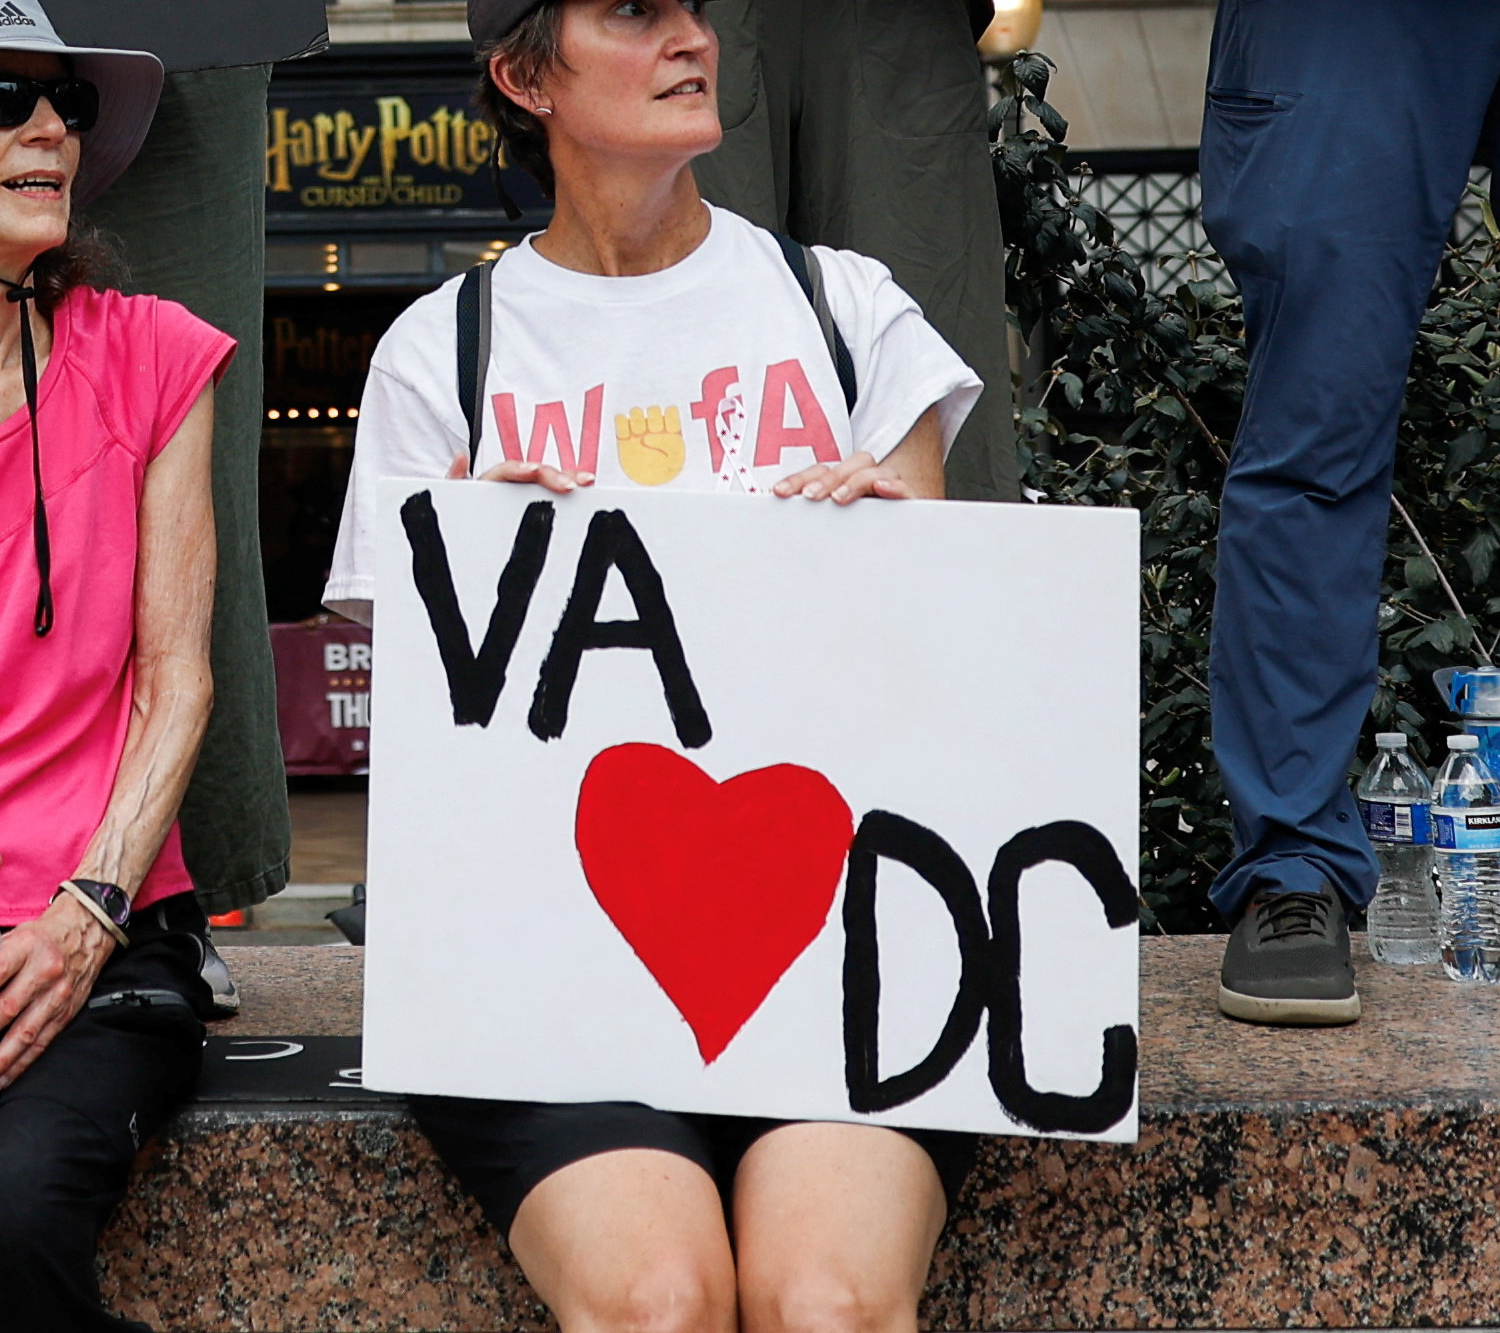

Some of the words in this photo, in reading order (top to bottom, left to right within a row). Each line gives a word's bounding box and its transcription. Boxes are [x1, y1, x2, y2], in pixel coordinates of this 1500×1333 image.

[390, 184, 464, 206] CHILD
[399, 489, 713, 749] VA
[842, 809, 1140, 1134] DC
